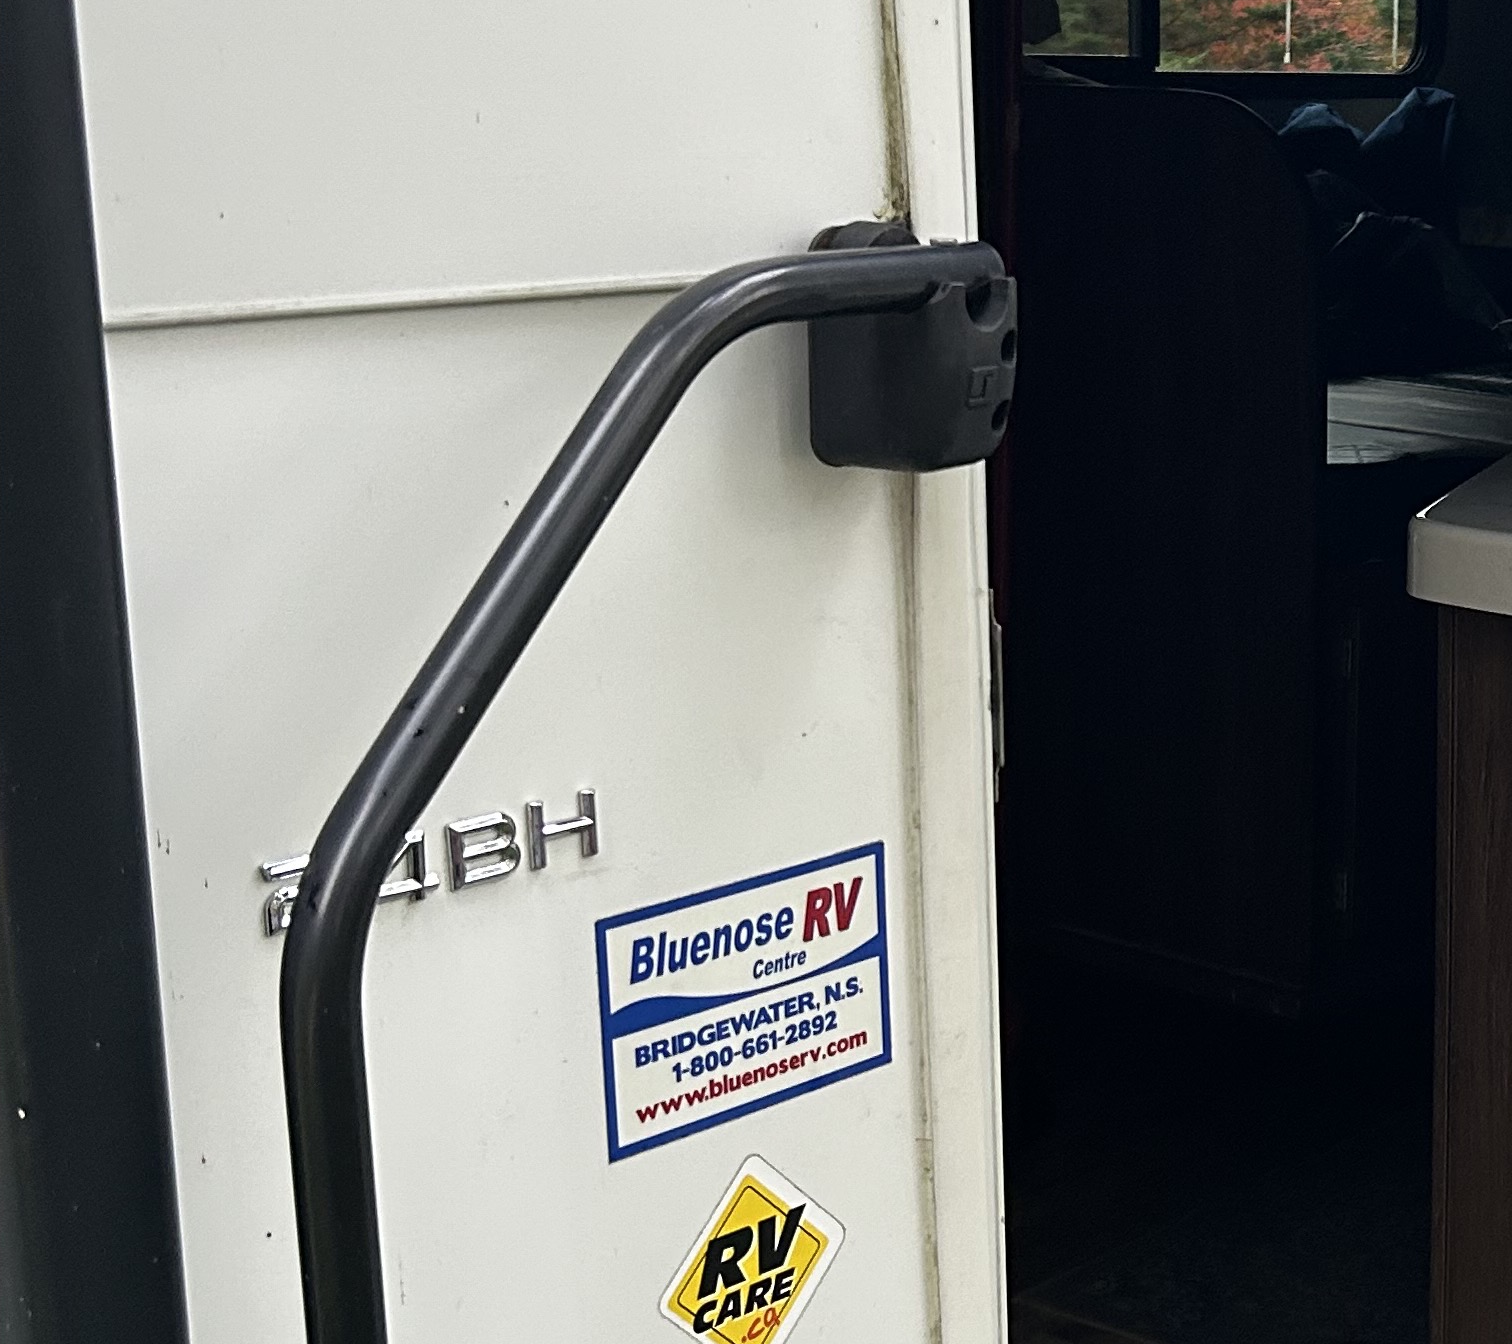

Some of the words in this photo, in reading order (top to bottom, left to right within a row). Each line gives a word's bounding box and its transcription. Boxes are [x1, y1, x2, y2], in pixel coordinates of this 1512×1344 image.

[629, 906, 794, 985] Bluenose
[802, 875, 863, 943] RV
[752, 950, 807, 979] Centre
[634, 990, 821, 1068] BRIDGEWATER,
[824, 976, 864, 1005] N.S.
[672, 1010, 838, 1083] 1-800-661-2892
[635, 1030, 868, 1123] www.bluenoserv.com
[697, 1202, 806, 1301] RV
[692, 1267, 796, 1334] CARE
[740, 1307, 780, 1343] .ca
